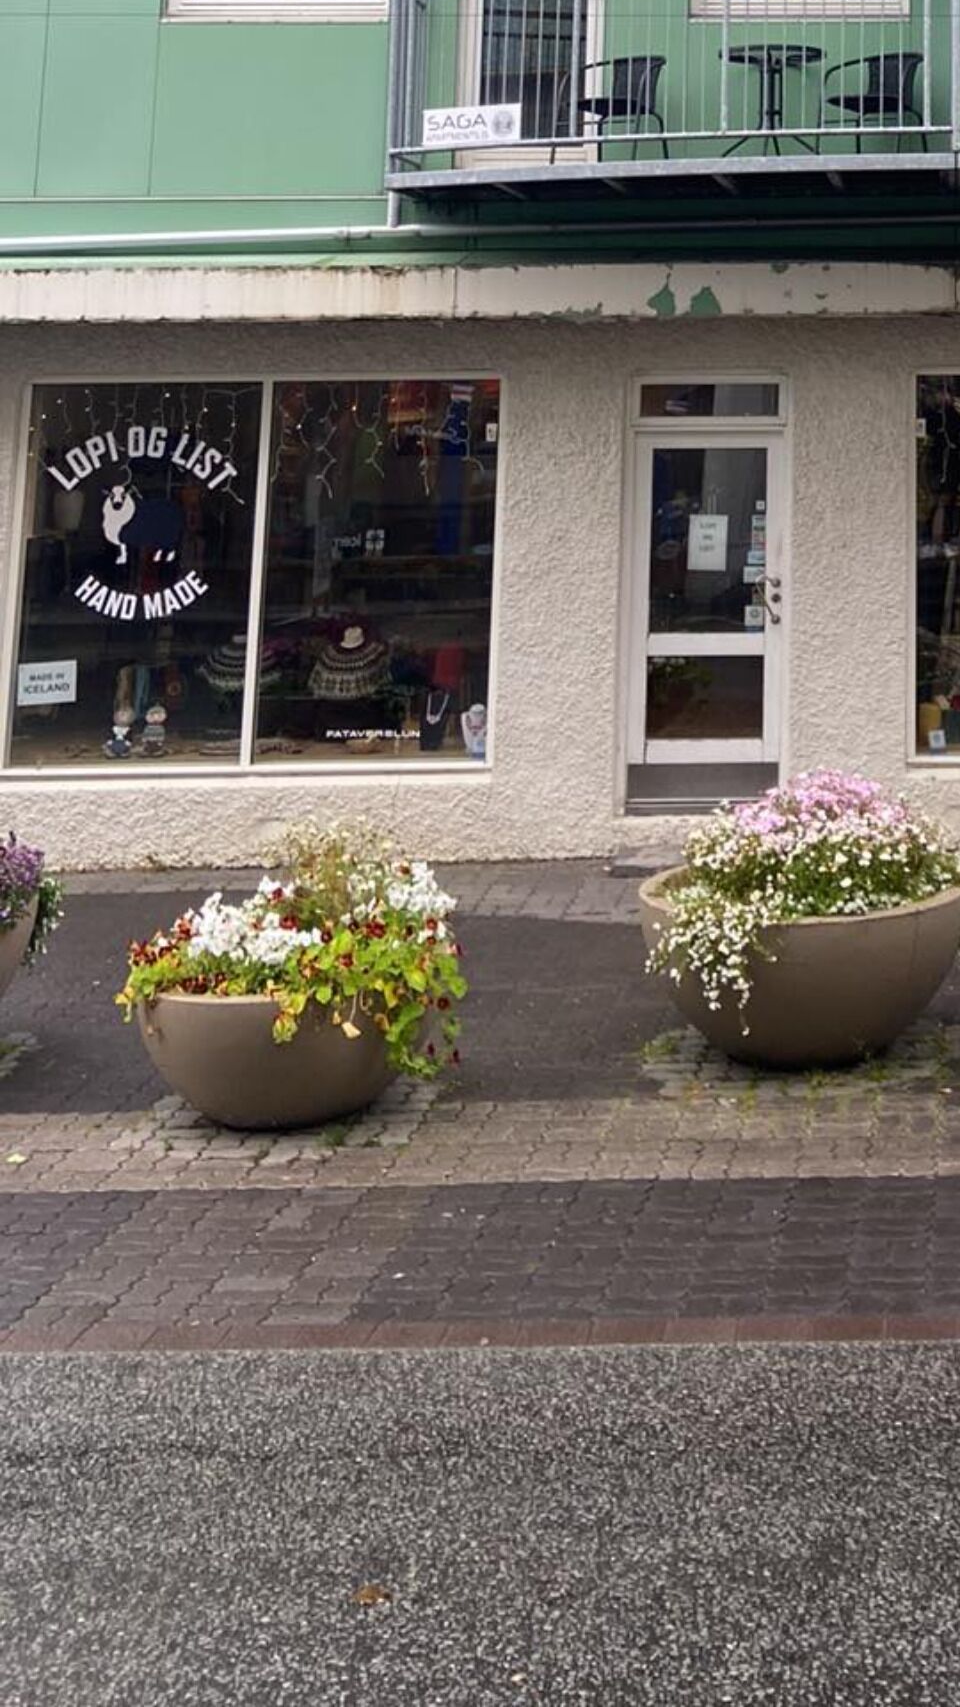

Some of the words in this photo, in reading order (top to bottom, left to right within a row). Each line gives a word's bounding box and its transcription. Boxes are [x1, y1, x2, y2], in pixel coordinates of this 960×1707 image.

[427, 113, 487, 131] SAGA
[48, 431, 119, 491] LOPI
[128, 426, 168, 458] OG
[171, 433, 238, 490] LIST
[74, 575, 137, 620] HAND
[143, 570, 209, 620] MADE
[23, 683, 70, 694] ICELAND
